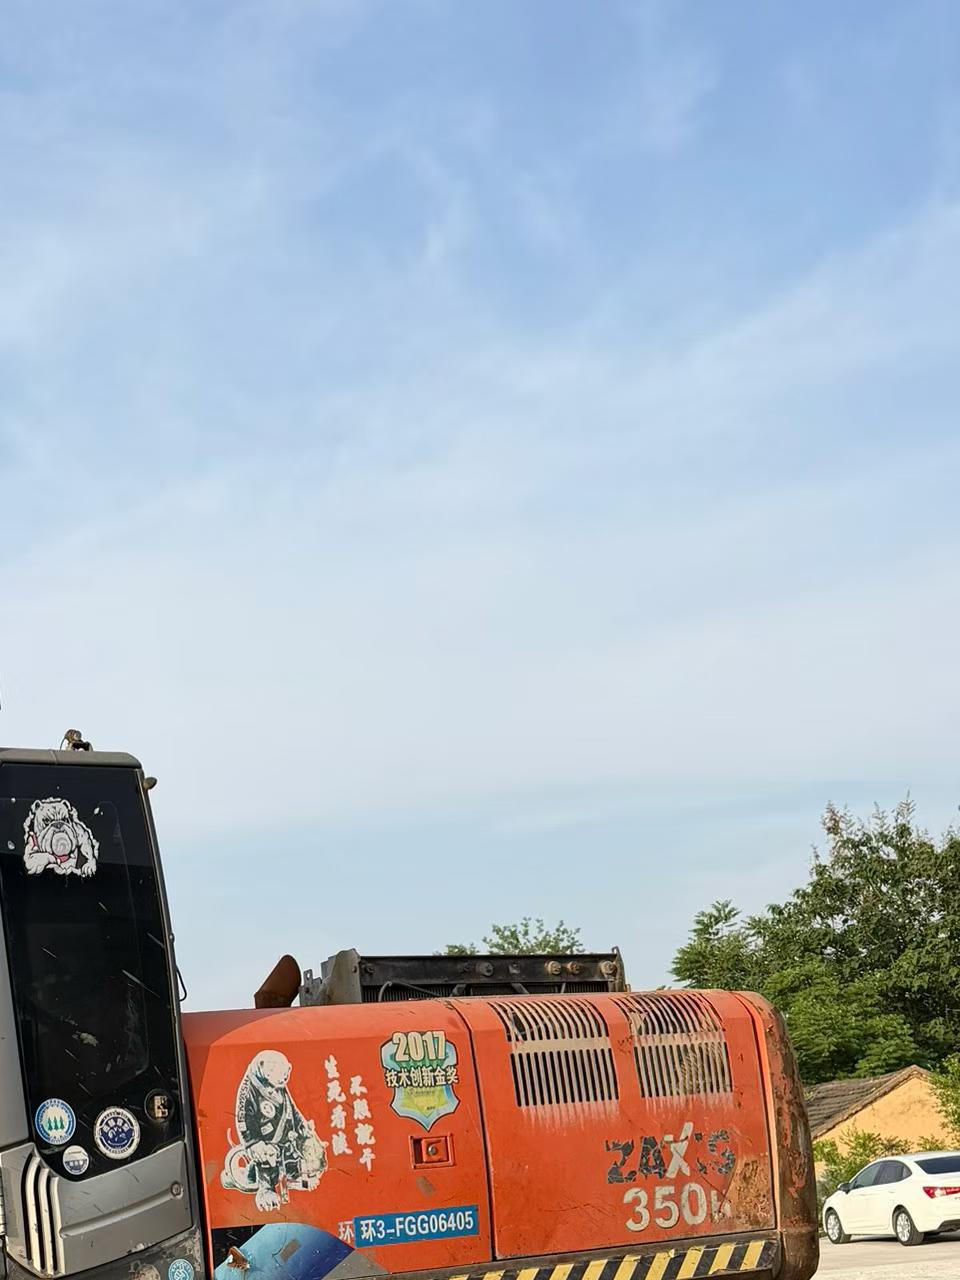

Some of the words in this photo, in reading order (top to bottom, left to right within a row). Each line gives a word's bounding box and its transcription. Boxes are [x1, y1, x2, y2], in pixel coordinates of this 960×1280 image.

[392, 1030, 446, 1062] 2017
[385, 1065, 458, 1088] 技术创新金奖
[605, 1121, 736, 1184] ZAXS
[360, 1211, 474, 1242] 环3-FGG06405
